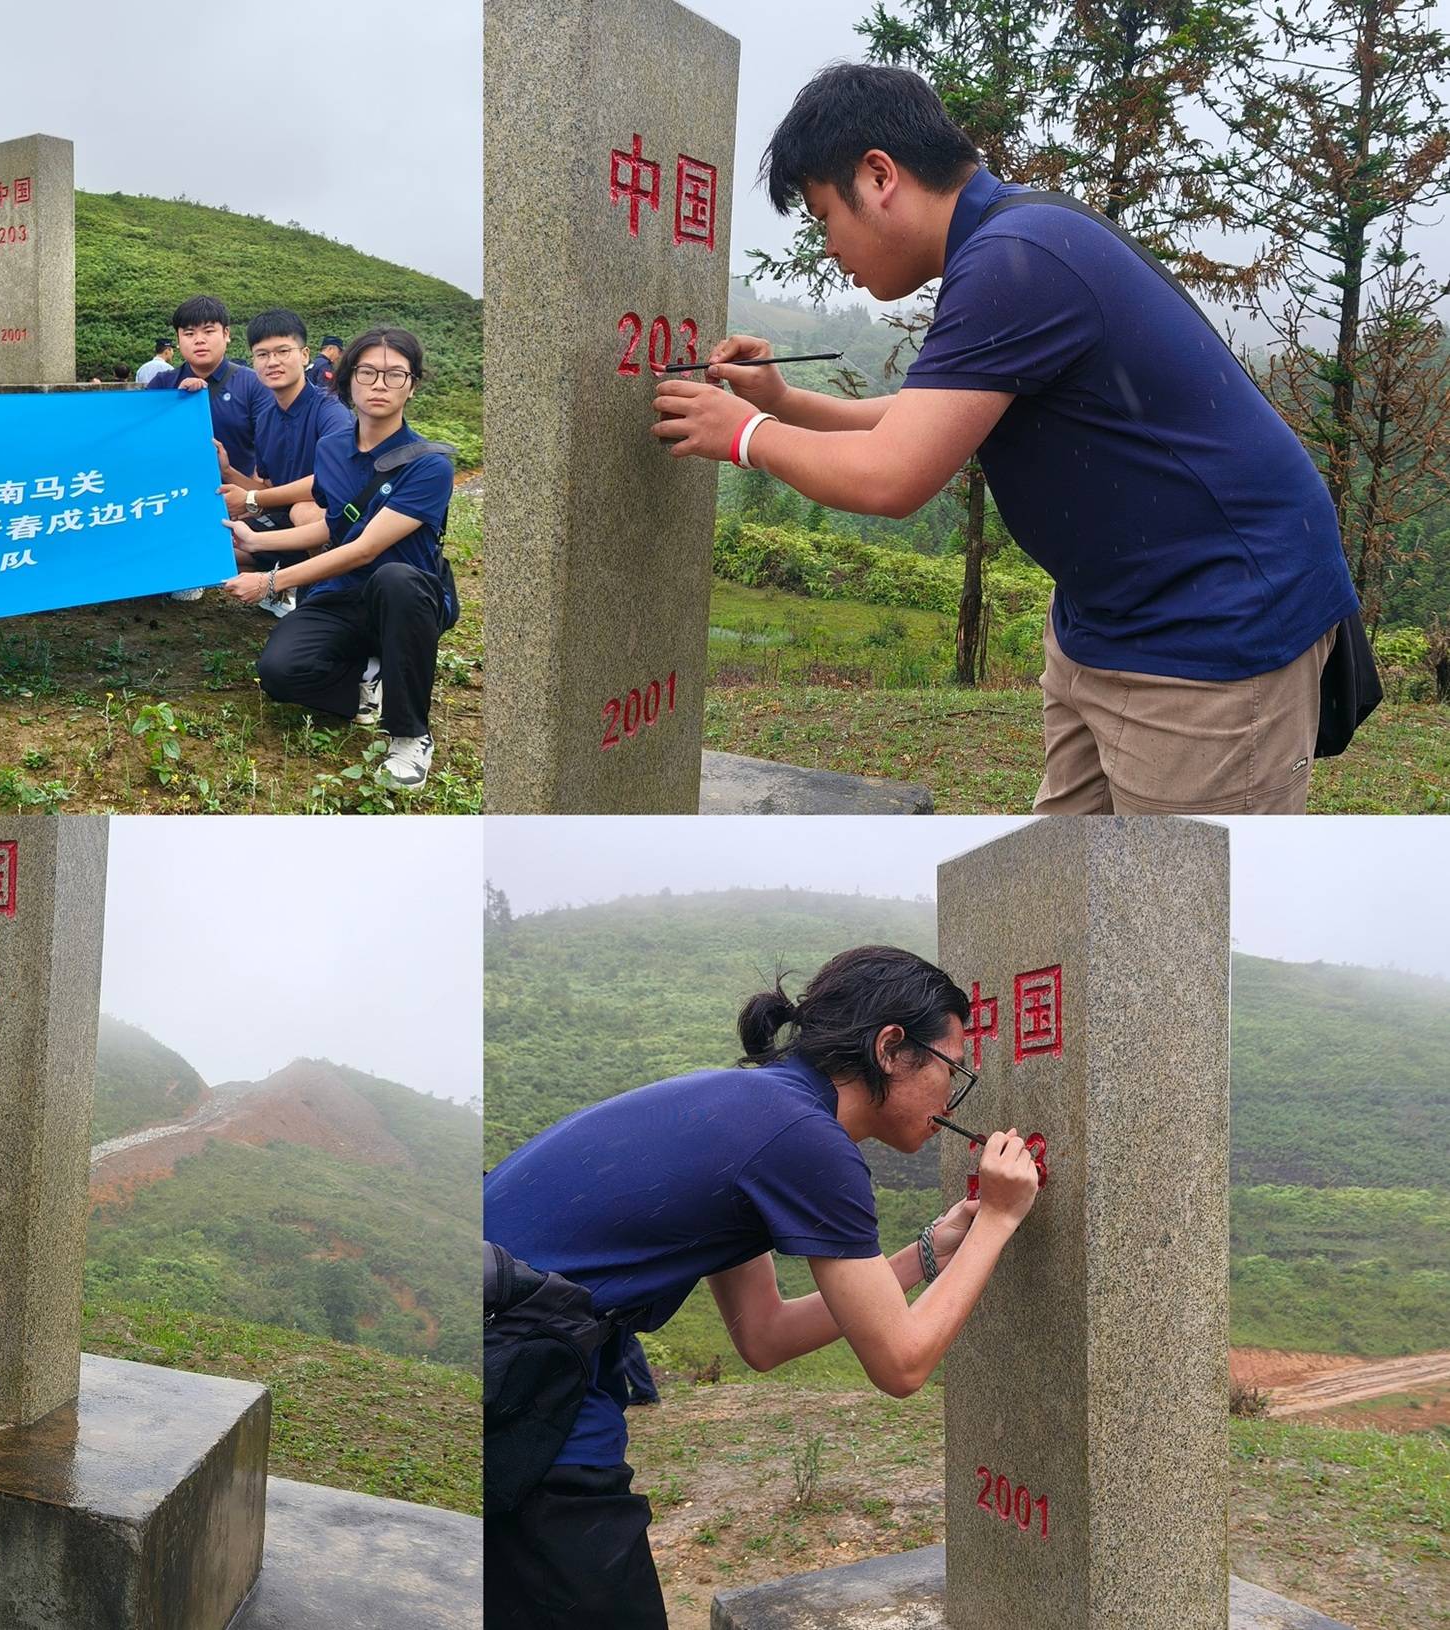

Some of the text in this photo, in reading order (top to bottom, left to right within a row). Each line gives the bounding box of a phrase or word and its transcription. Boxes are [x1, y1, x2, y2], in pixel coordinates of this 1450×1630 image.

[608, 134, 718, 253] 中国
[1, 328, 28, 342] 2001
[616, 312, 699, 378] 203
[599, 670, 677, 752] 2001
[963, 963, 1063, 1071] 中国
[976, 1465, 1049, 1541] 2001
